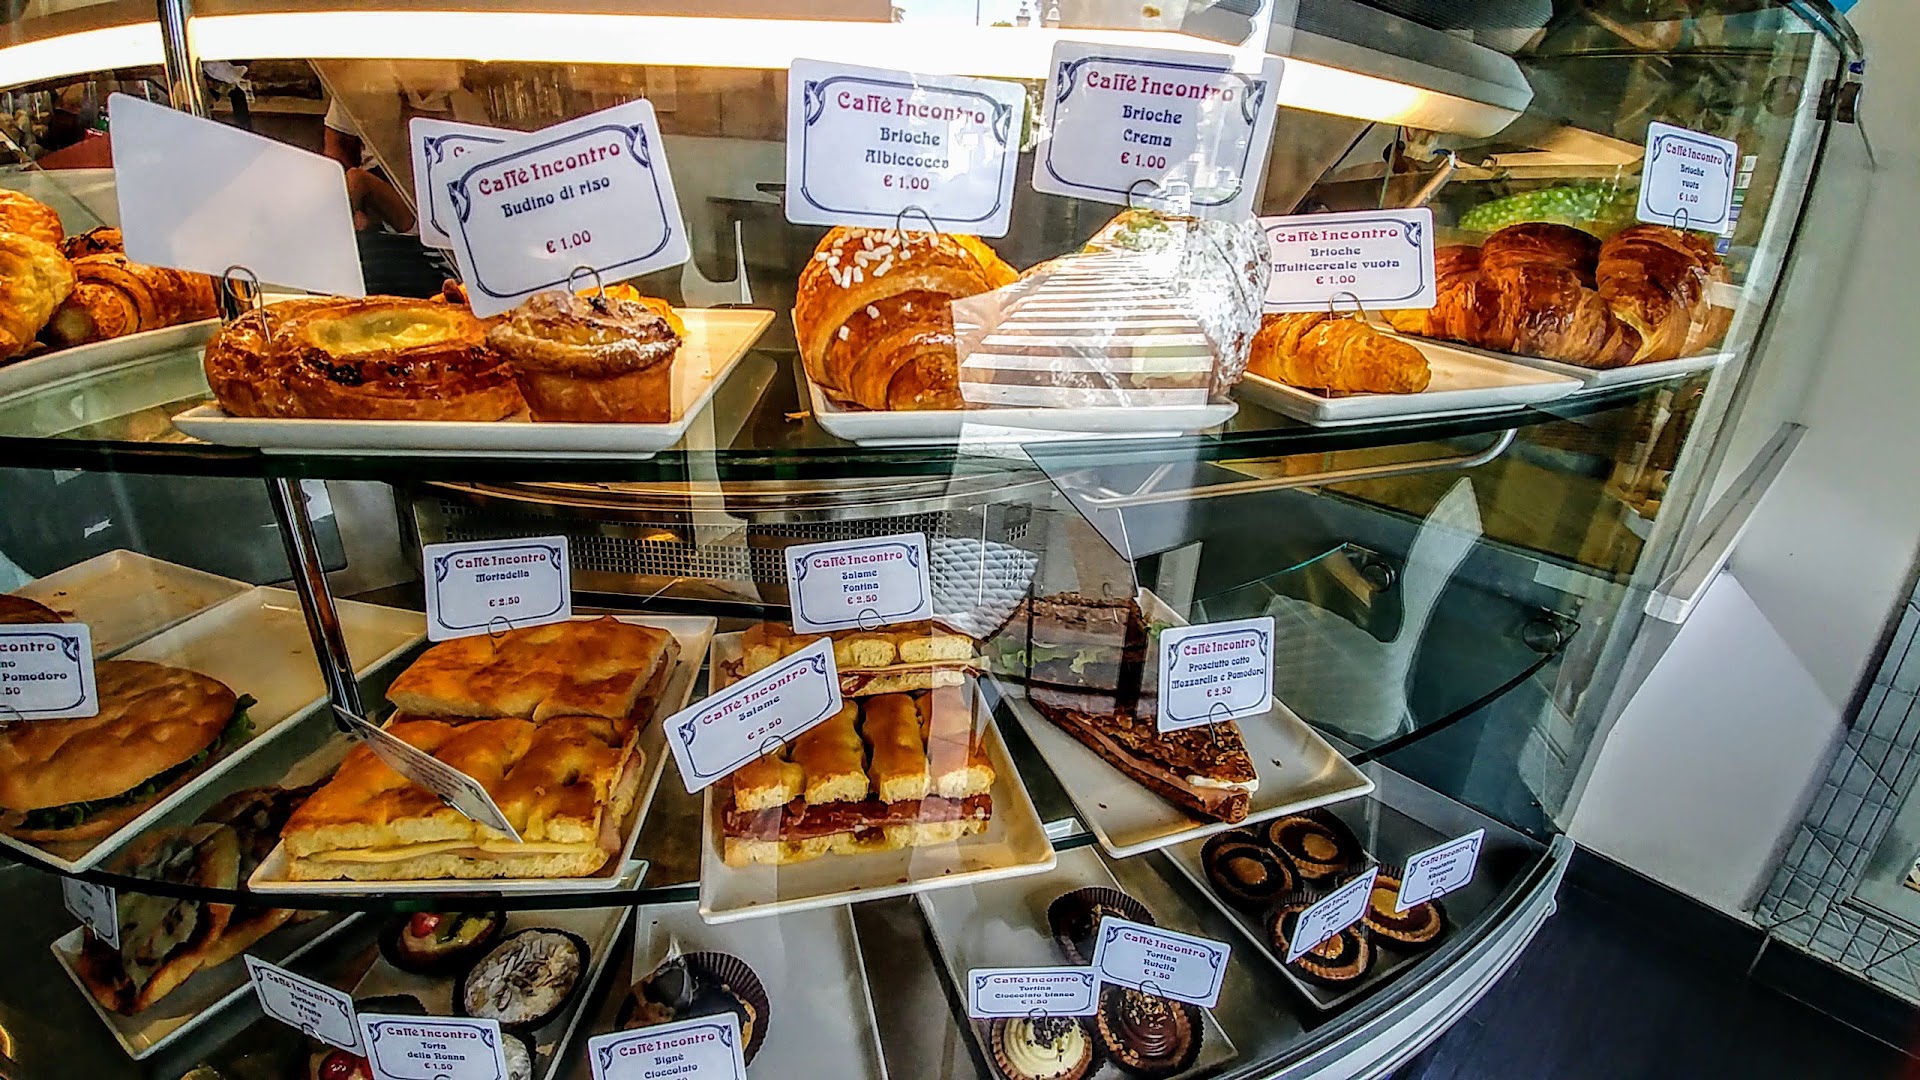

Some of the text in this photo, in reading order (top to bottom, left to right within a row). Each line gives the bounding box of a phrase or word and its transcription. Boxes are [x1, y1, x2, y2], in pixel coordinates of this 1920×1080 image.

[1087, 71, 1234, 102] Caffè Incontro
[837, 91, 986, 124] Caffè Incontro
[1121, 105, 1183, 125] Brioche
[880, 127, 940, 147] Brioche
[1123, 129, 1172, 147] Crema
[865, 149, 949, 169] Albiccocca
[1120, 152, 1166, 169] € 1.00
[1688, 148, 1723, 165] Incontro
[479, 143, 621, 196] Caffè Incontro
[1680, 164, 1705, 176] Brioche
[883, 175, 930, 190] € 1.00
[501, 176, 610, 218] Budino di riso
[1685, 193, 1698, 203] 1.00
[546, 230, 592, 254] € 1.00
[1276, 228, 1399, 243] Caffè Incontro
[1310, 246, 1361, 257] Brioche
[1274, 259, 1400, 272] Multicereale vuota
[1316, 274, 1356, 285] € 1.00
[455, 553, 547, 569] Caffè Incontro
[813, 551, 903, 569] Caffè Incontro
[476, 569, 530, 583] Mortadella
[842, 569, 878, 580] Salame
[843, 582, 879, 593] Fontina
[489, 596, 520, 607] € 2.50
[847, 594, 878, 605] € 2.50
[1184, 638, 1256, 656] Caffè Incontro
[1189, 656, 1250, 672] Prosciutto cotto
[2, 672, 67, 681] Pomodoro
[1171, 674, 1218, 689] Mozzarella
[1227, 667, 1264, 681] Pomodoro
[702, 667, 808, 725] Caffè Incontro
[1207, 686, 1232, 697] € 2.50
[738, 695, 781, 722] Salame
[747, 717, 783, 741] € 2.50
[1146, 949, 1177, 963] Tortina
[1155, 938, 1206, 959] Incontro
[1026, 976, 1079, 984] Incontro
[1152, 971, 1171, 980] 1.50
[421, 1028, 478, 1039] Incontro
[420, 1041, 447, 1050] Torta
[619, 1032, 716, 1057] Caffè Incontro
[407, 1051, 431, 1059] della
[644, 1063, 698, 1079] Cioccolato
